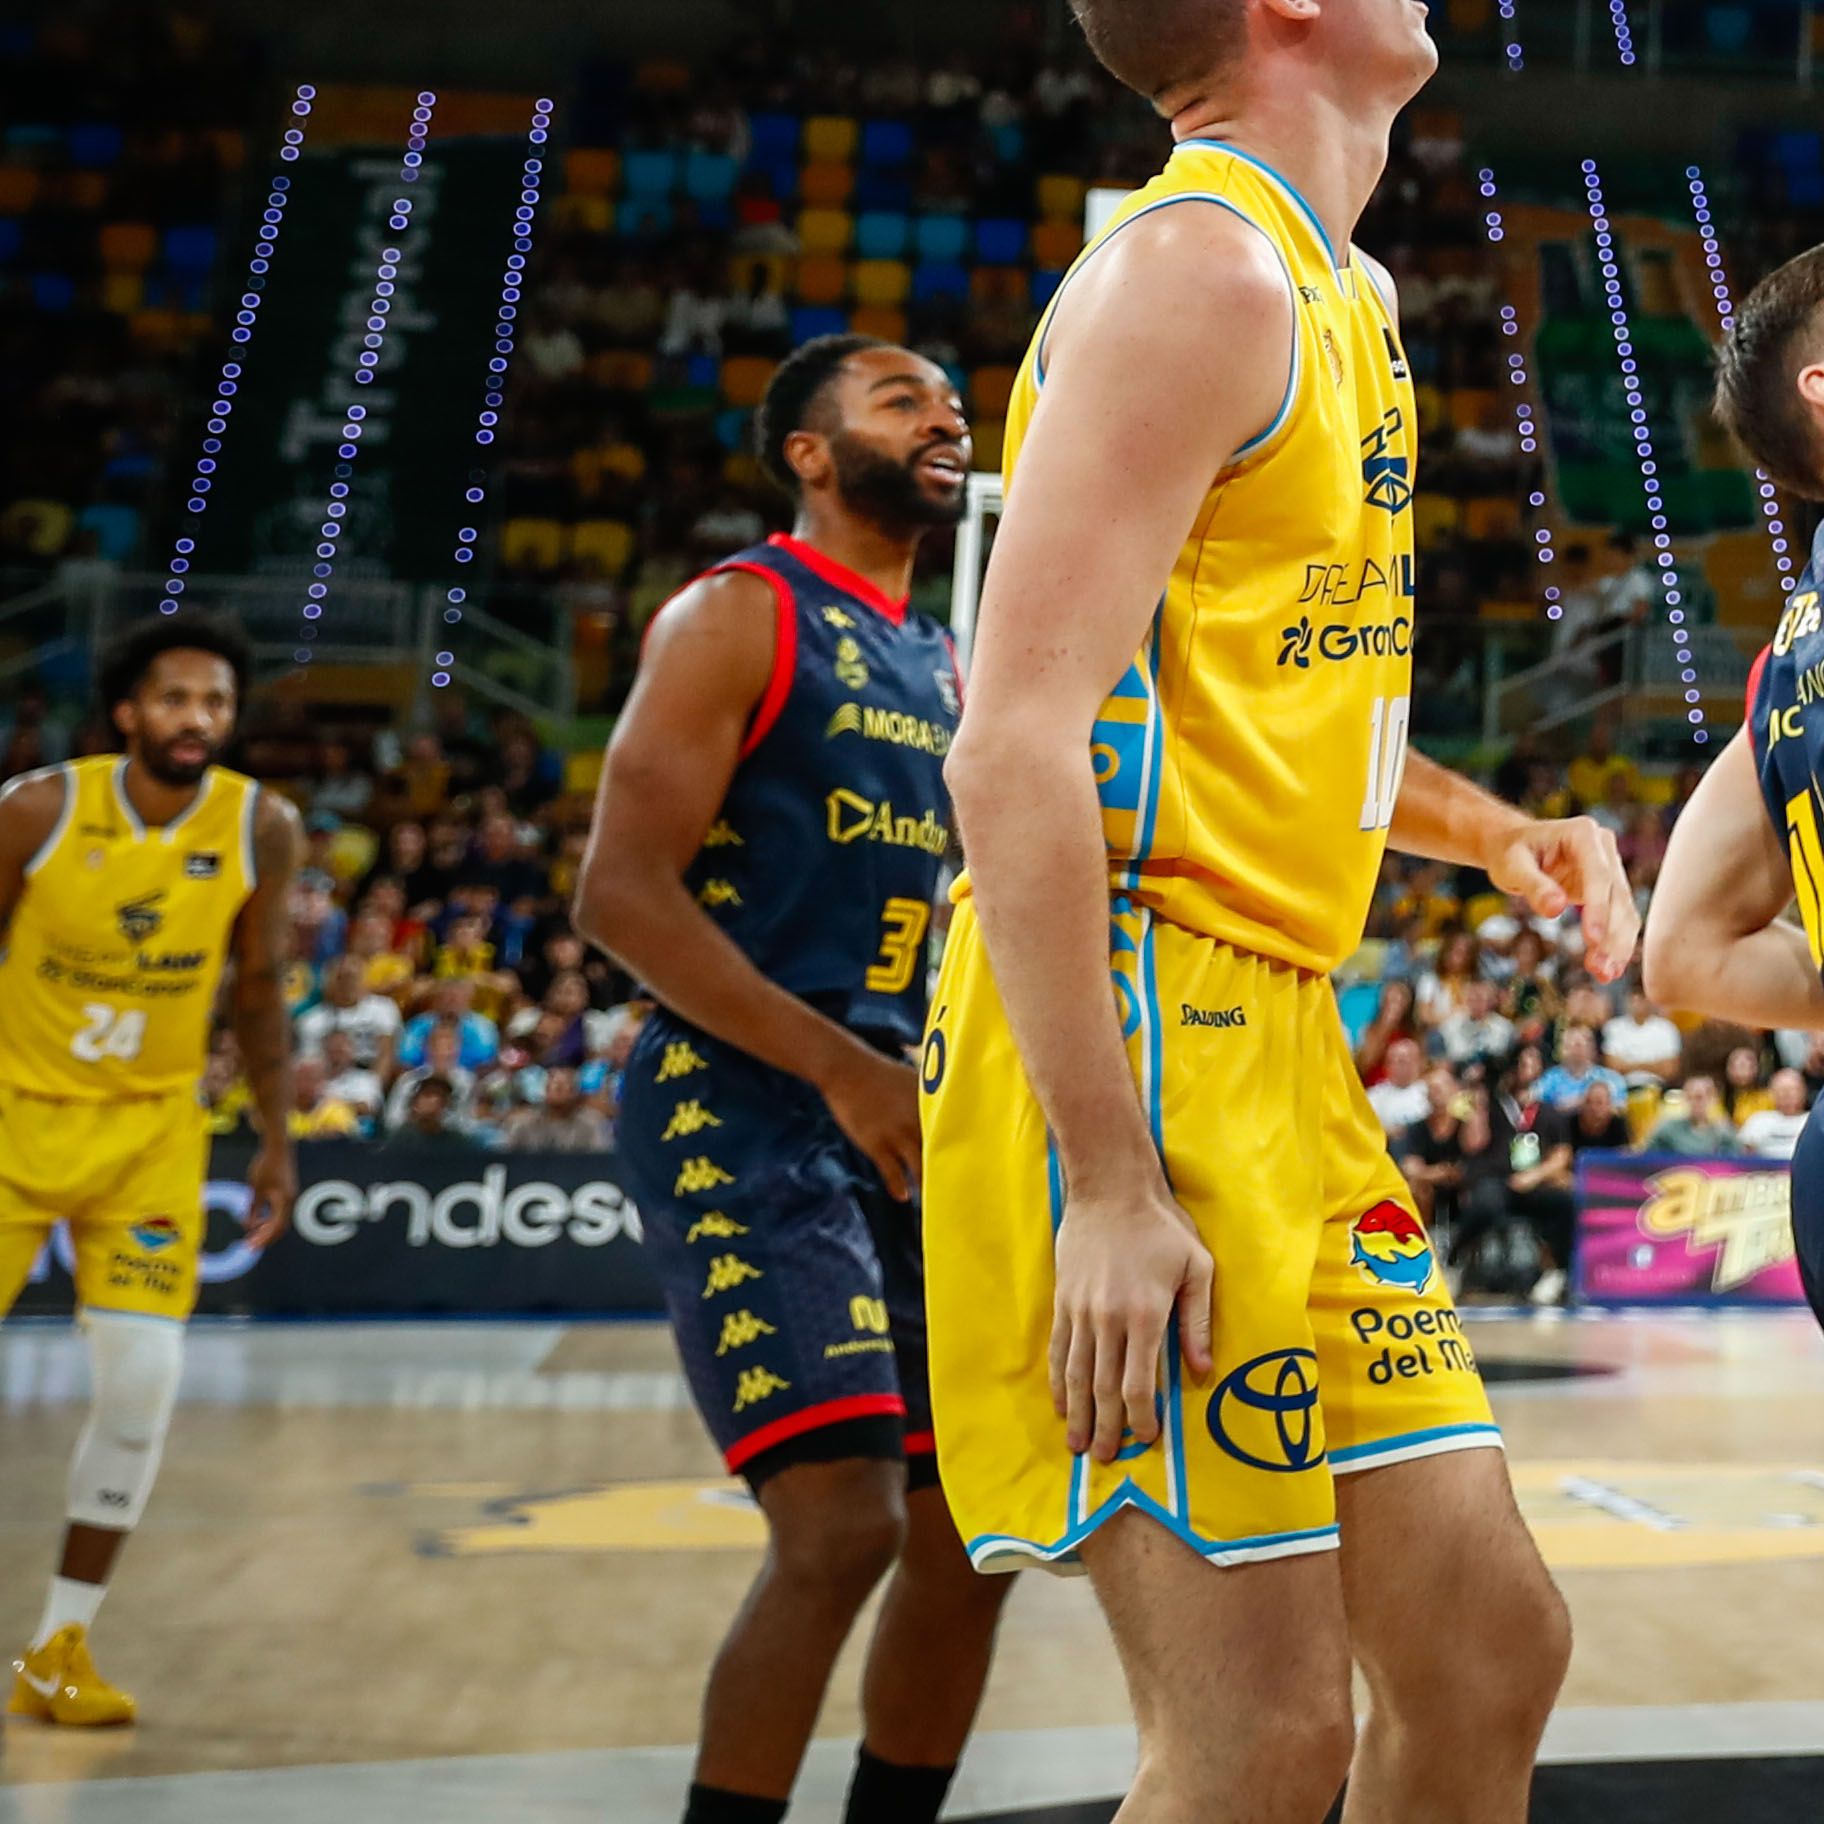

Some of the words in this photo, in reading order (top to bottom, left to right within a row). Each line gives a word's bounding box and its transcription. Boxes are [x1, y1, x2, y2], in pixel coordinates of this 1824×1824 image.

[282, 158, 444, 464] Tropical
[865, 897, 931, 993] 3
[70, 1001, 147, 1062] 24
[1367, 1344, 1434, 1386] del
